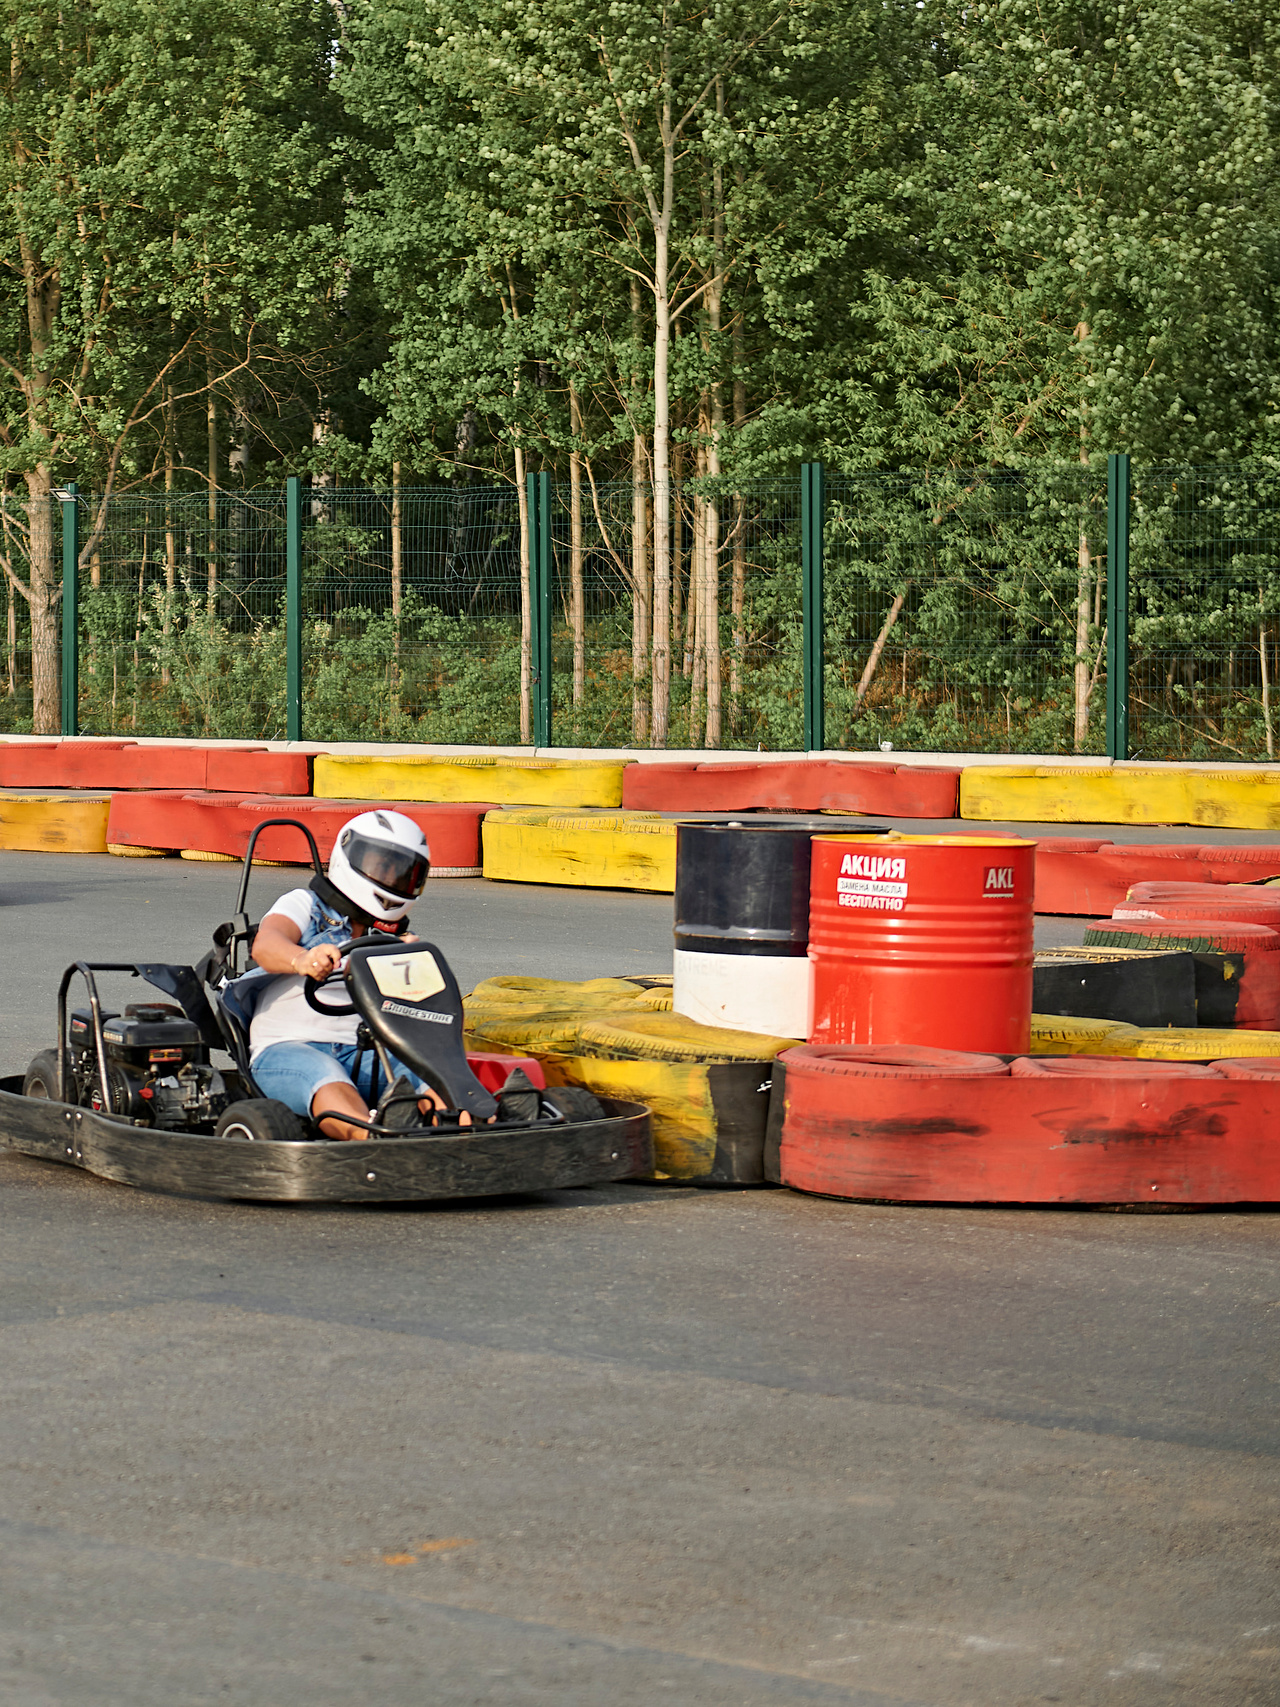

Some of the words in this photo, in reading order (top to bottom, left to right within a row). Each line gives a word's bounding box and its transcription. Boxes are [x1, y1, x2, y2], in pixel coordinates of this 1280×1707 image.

[840, 854, 906, 880] АКЦИЯ
[840, 880, 869, 892] ЗАМЕНА
[872, 884, 902, 895] МАСЛА
[839, 893, 903, 911] БЕСПЛАТНО
[392, 960, 411, 985] 7
[384, 1001, 451, 1023] BRIDGESTONE
